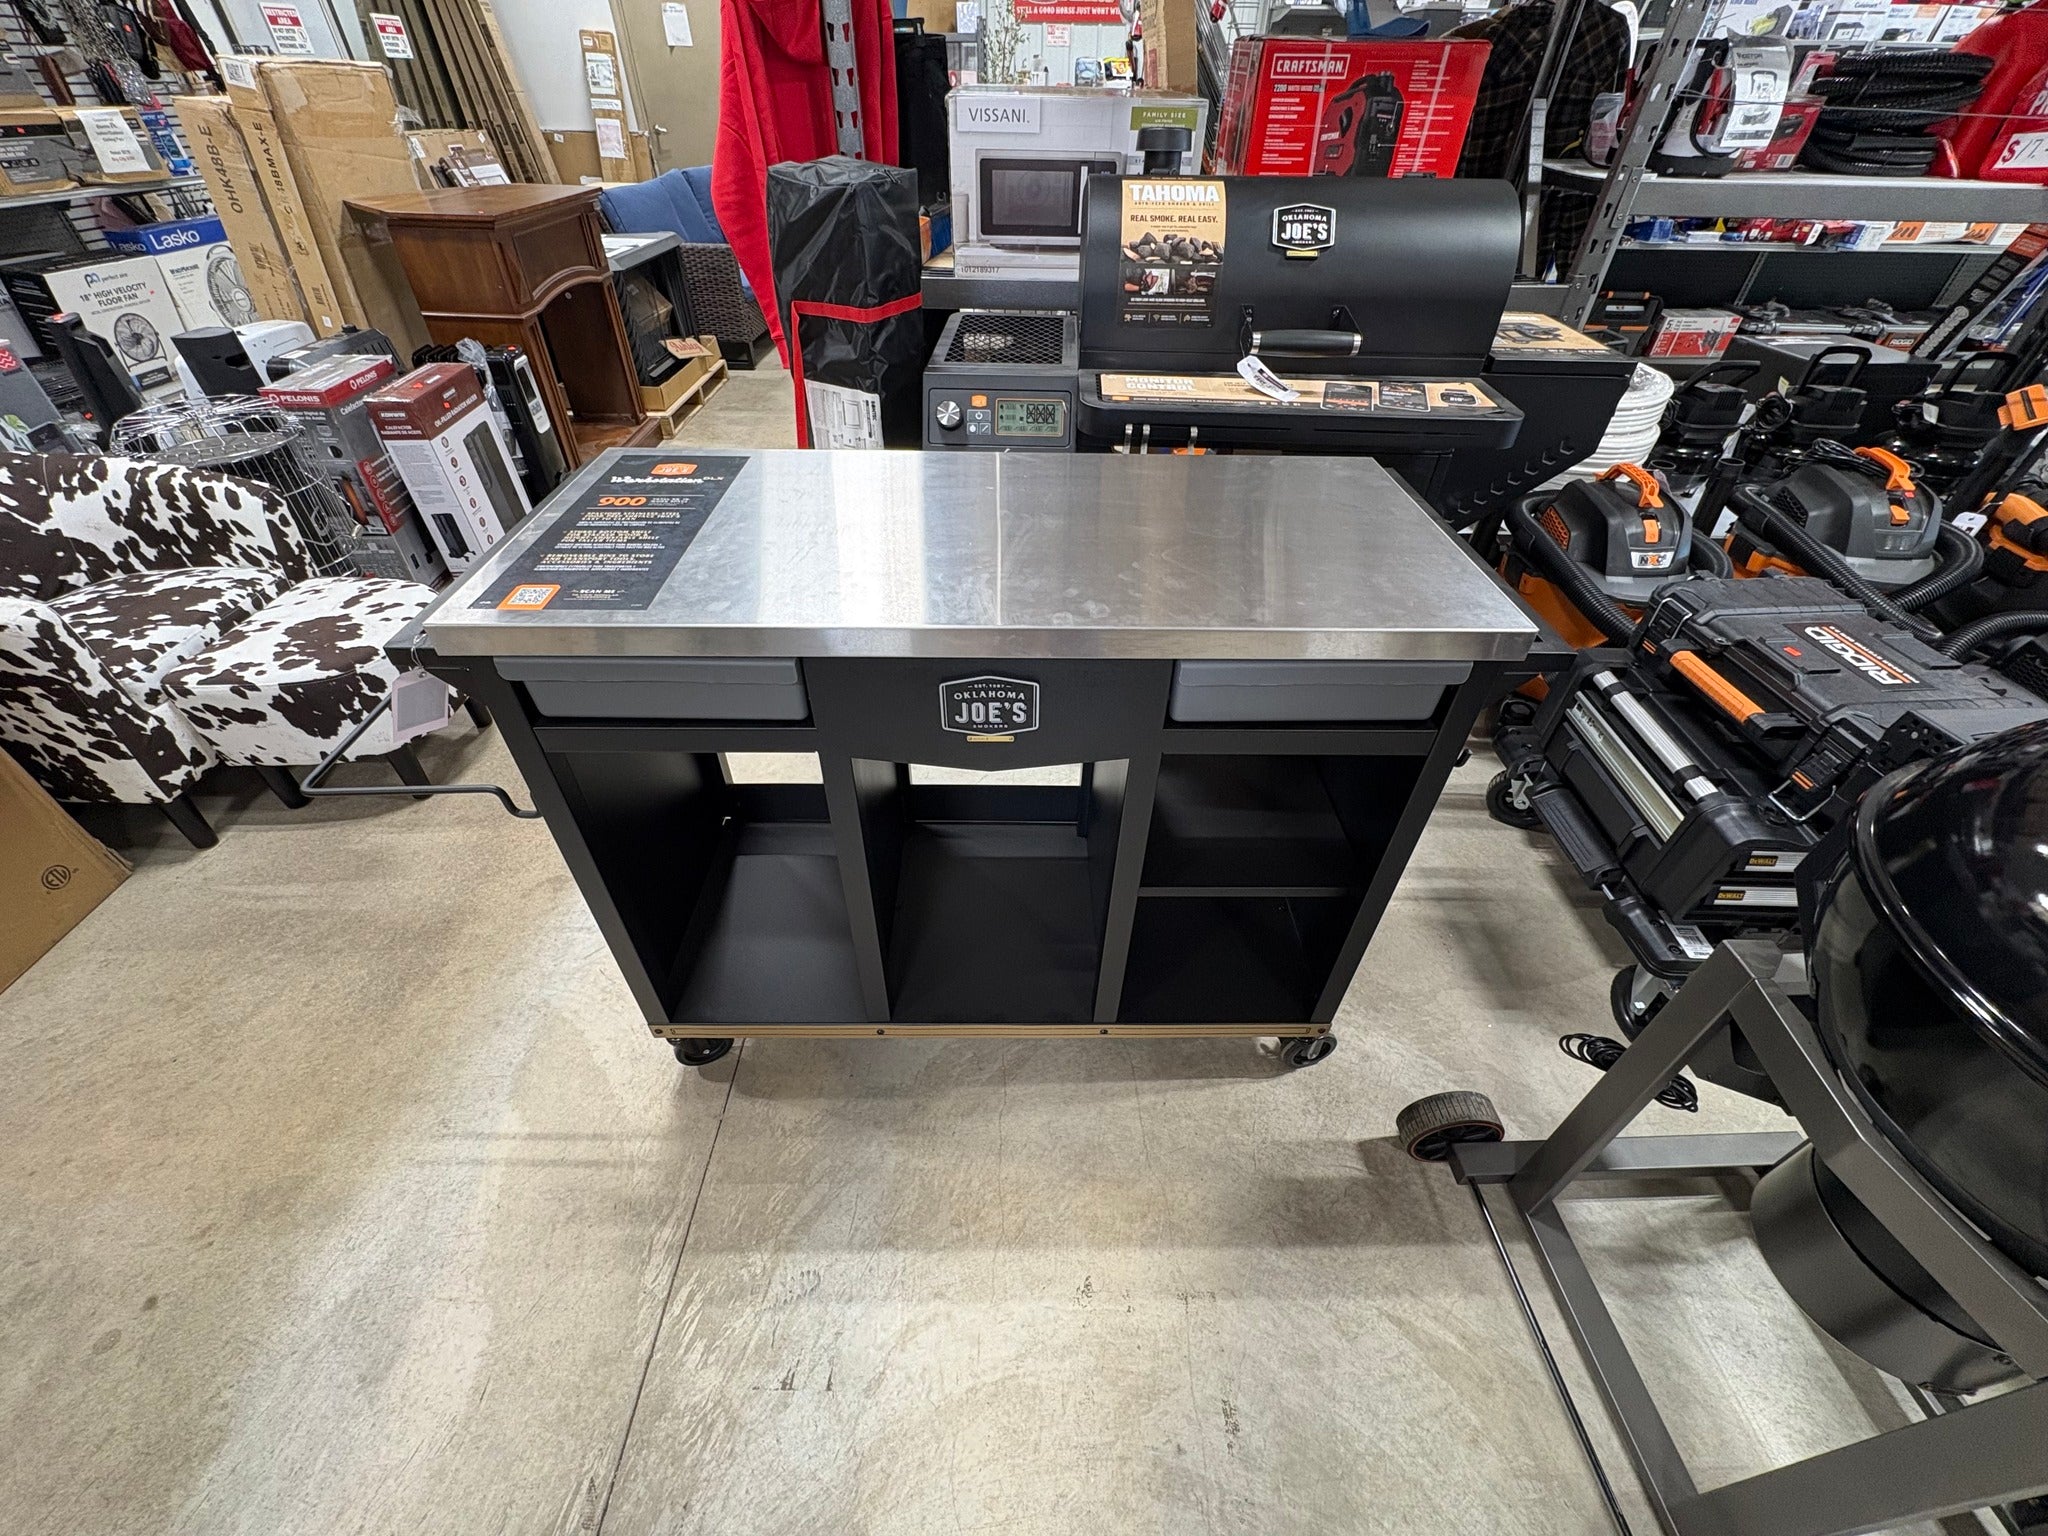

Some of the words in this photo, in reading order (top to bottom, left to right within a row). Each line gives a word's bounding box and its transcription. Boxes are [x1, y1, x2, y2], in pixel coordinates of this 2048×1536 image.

[265, 8, 298, 18] RESTRICTED
[1039, 6, 1055, 15] GOOD
[1056, 6, 1076, 15] HORSE
[1076, 6, 1091, 16] JUST
[1276, 60, 1345, 73] CRAFTSMAN
[1129, 184, 1220, 202] TAHOMA
[1130, 214, 1148, 222] REAL
[1150, 215, 1176, 223] SMOKE.
[1178, 215, 1197, 223] REAL
[1198, 216, 1219, 224] EASY.
[1281, 213, 1327, 222] OKLAHOMA
[1281, 222, 1329, 240] JOE'S
[149, 229, 200, 250] Lasko
[111, 240, 147, 251] Lasko
[93, 288, 113, 300] HIGH
[112, 282, 147, 295] VELOCITY
[98, 295, 123, 308] FLOOR
[123, 293, 139, 303] FAN
[356, 370, 378, 386] PELONIS
[1125, 377, 1194, 385] MONITOR
[1126, 383, 1194, 391] CONTROL
[280, 394, 320, 404] PELONIS
[597, 496, 647, 507] 900
[1804, 626, 1903, 685] RIDGID
[953, 690, 1026, 700] OKLAHOMA
[954, 701, 1027, 724] JOE'S
